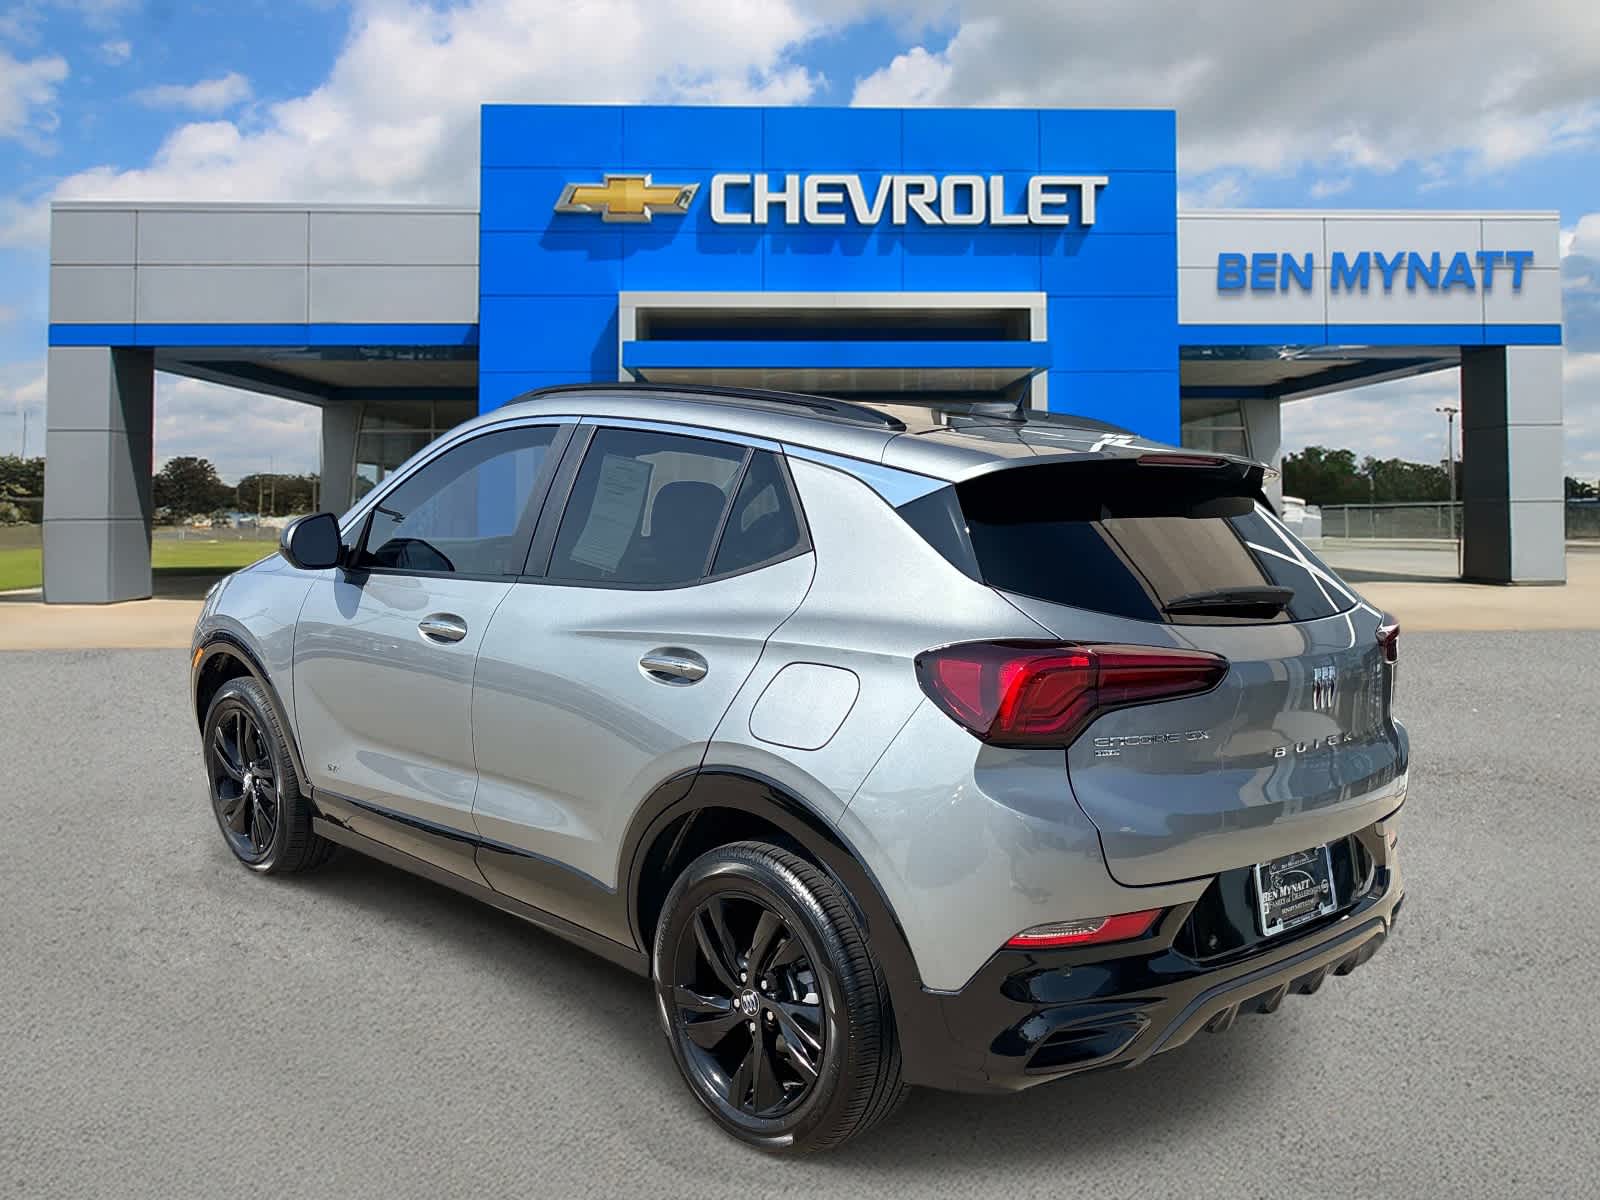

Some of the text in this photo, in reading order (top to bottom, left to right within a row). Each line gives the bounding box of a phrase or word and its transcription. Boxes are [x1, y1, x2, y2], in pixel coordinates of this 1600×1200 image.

[710, 173, 1110, 226] CHEVROLET
[1217, 250, 1535, 291] BEN MYNATT
[1273, 733, 1353, 759] BUICK
[1263, 879, 1310, 902] BEN MYNATT
